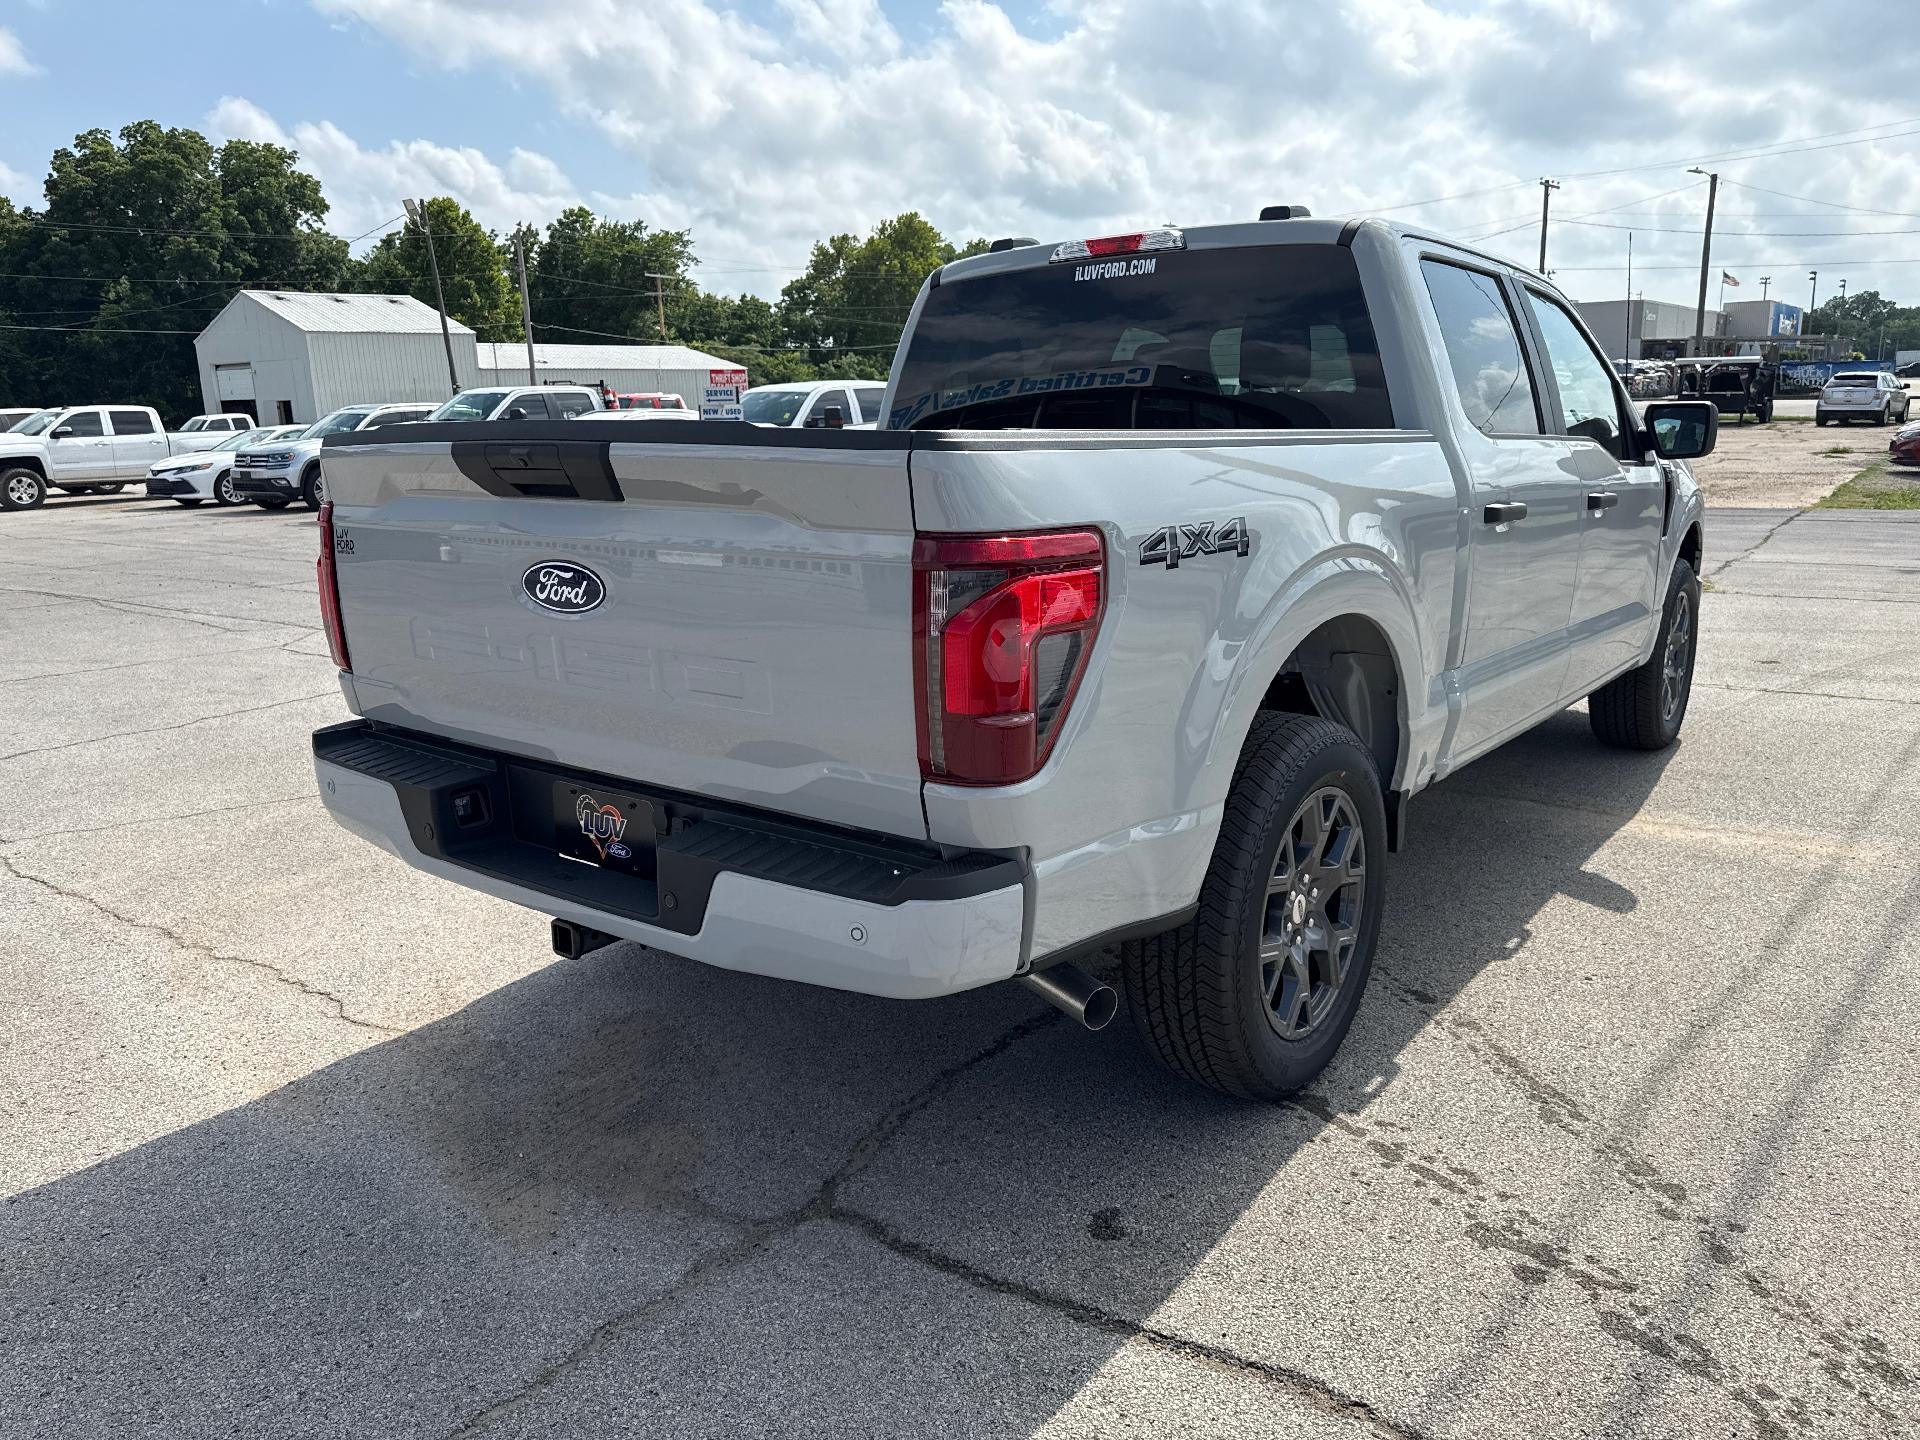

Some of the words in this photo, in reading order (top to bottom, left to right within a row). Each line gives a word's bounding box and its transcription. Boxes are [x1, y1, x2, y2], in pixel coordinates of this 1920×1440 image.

[1074, 258, 1157, 281] iLUVFORD.COM
[1787, 369, 1823, 379] TRUCK
[705, 389, 733, 397] SERVICE
[336, 539, 355, 551] FORD
[535, 568, 588, 604] Ford
[581, 809, 628, 840] LUV
[609, 843, 627, 857] Ford
